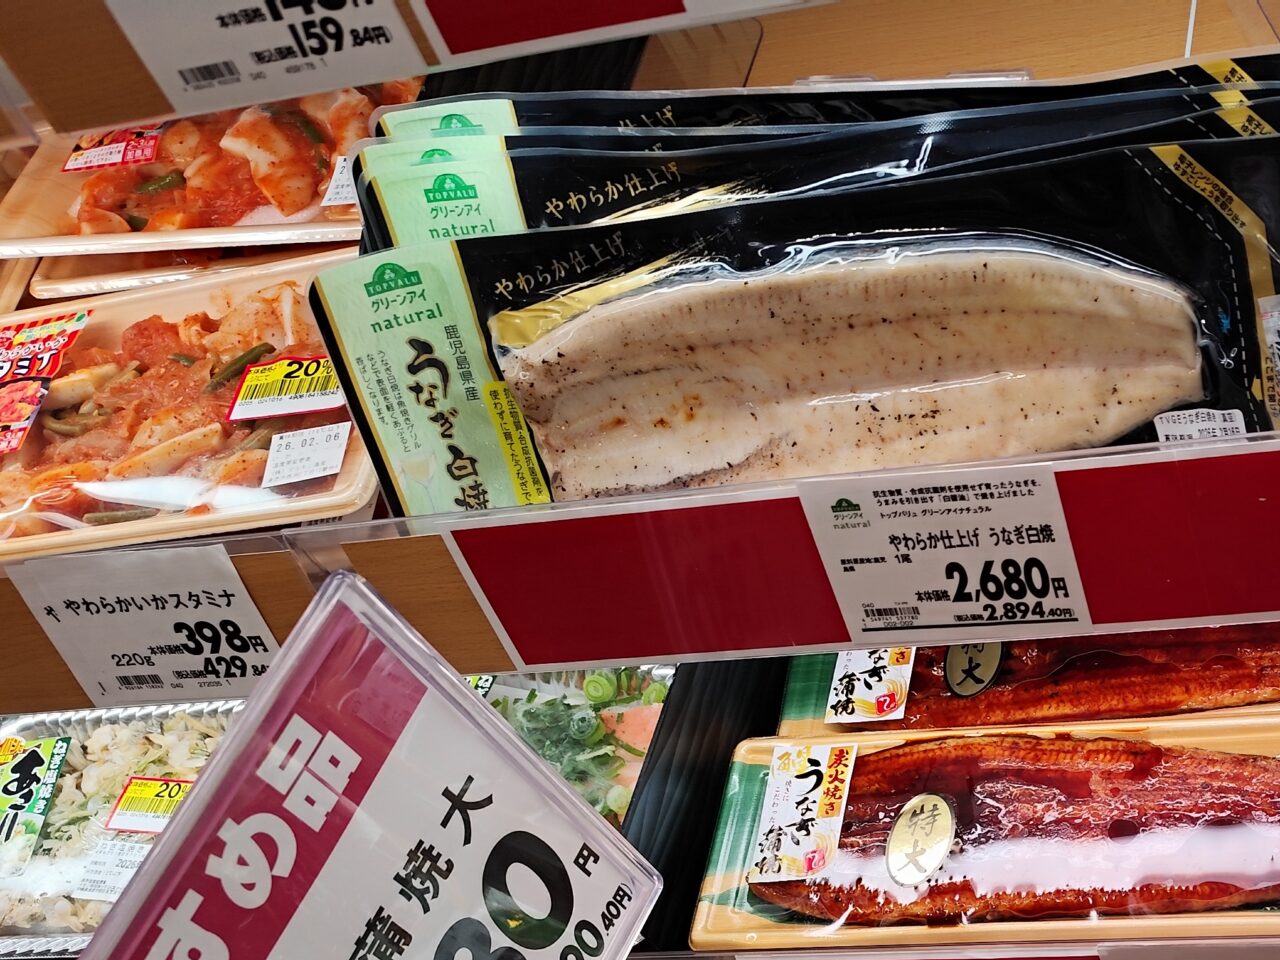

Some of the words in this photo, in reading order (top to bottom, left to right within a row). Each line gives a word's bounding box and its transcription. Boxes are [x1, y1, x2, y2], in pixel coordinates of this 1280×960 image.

[427, 187, 478, 201] TOPVALU
[545, 161, 684, 220] やわらか仕上げ
[430, 203, 482, 219] グリーンアイ
[429, 219, 496, 239] natural
[494, 230, 626, 299] やわらか仕上げ
[367, 275, 421, 295] TOPVALU
[371, 288, 428, 313] グリーンアイ
[370, 303, 444, 334] natural
[444, 325, 480, 401] 鹿児島県産
[833, 519, 871, 530] natural
[888, 527, 980, 552] やわらか仕上げ
[989, 524, 1056, 548] うなぎ白焼
[63, 588, 236, 617] やわらかいかスタミナ
[111, 652, 156, 667] 220g
[34, 740, 68, 813] ねぎ塩焼き
[822, 748, 851, 816] 炭火焼き
[786, 757, 824, 846] うなぎ
[754, 827, 788, 876] 蒲焼
[897, 803, 943, 875] 特大
